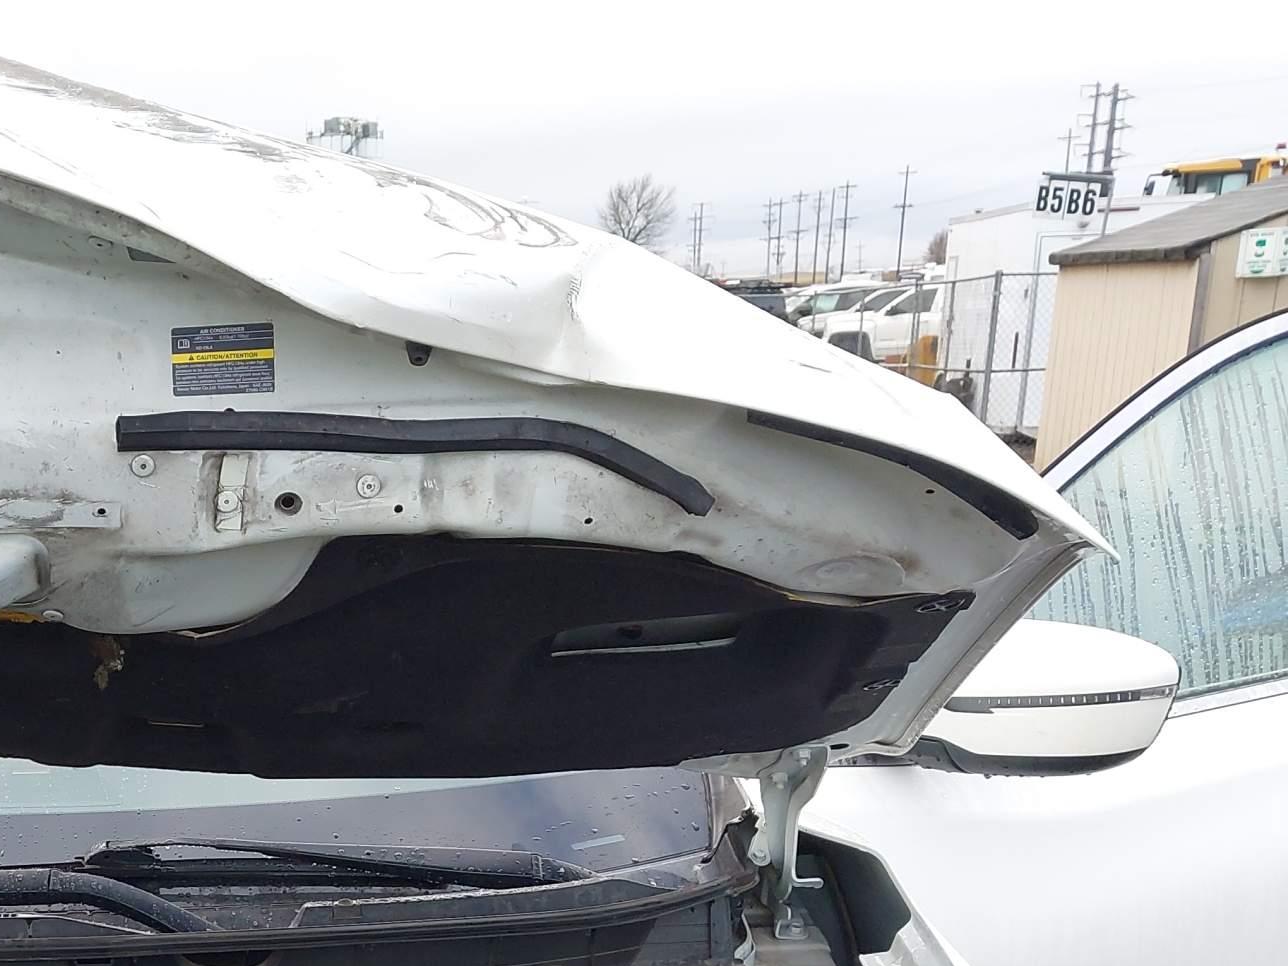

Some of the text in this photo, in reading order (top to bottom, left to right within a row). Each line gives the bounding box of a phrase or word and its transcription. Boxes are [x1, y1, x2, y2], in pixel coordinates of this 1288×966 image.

[1035, 185, 1097, 216] B5 B6
[210, 326, 245, 334] CONDITIONER
[196, 351, 258, 361] CAUTION/ATTENTION
